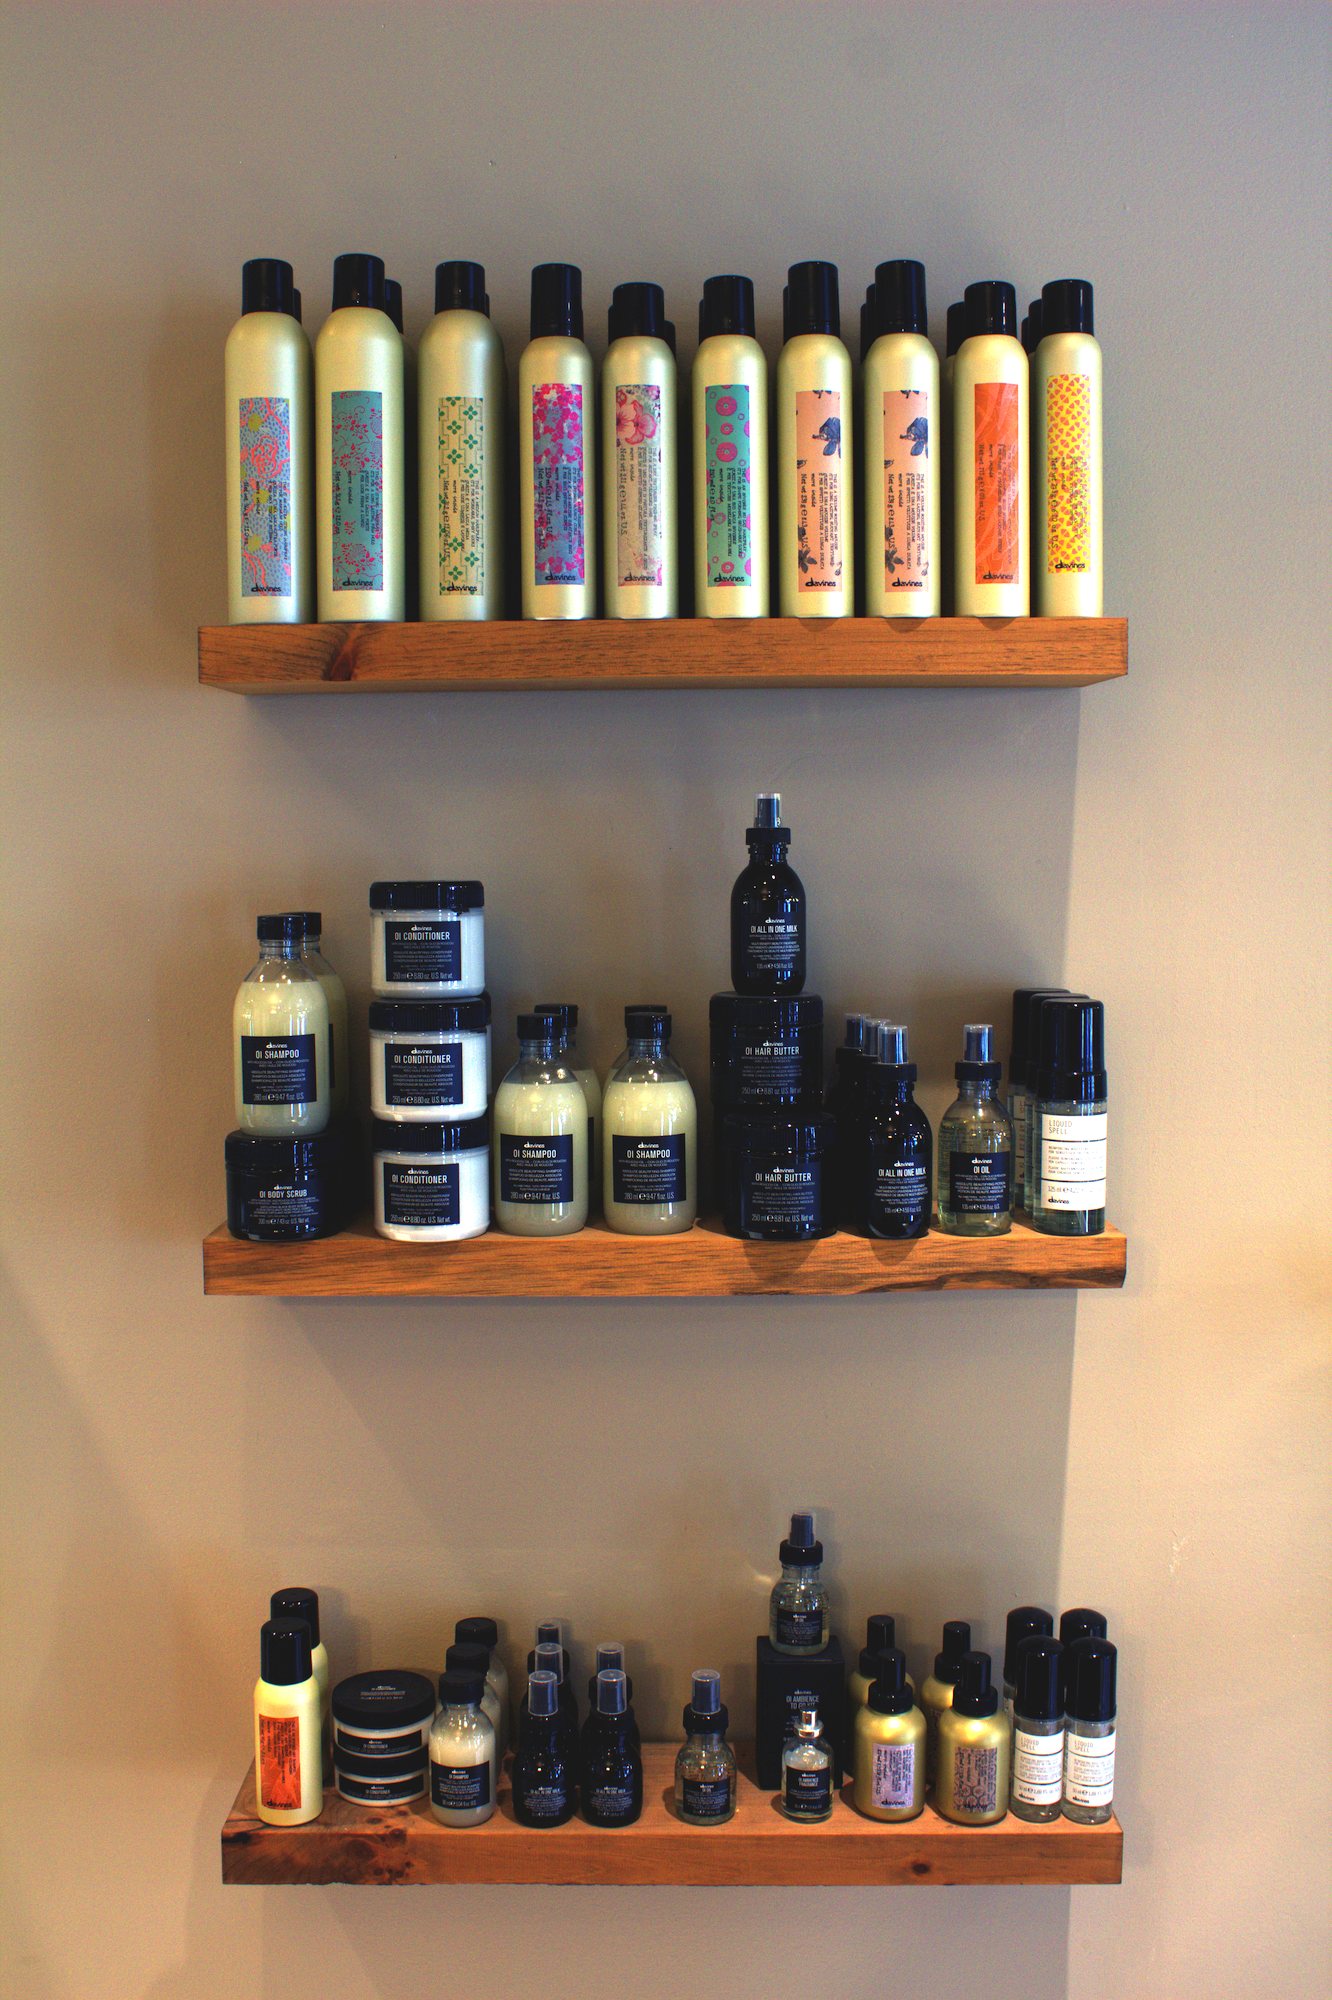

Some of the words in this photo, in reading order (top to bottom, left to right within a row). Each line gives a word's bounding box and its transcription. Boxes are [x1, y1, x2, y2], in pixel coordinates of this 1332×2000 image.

[1055, 560, 1086, 570] davines
[544, 571, 575, 582] davines
[624, 572, 655, 583] davines
[714, 573, 745, 583] davines
[982, 571, 1014, 581] davines
[342, 578, 374, 588] davines
[805, 577, 837, 587] davines
[892, 578, 923, 588] davines
[251, 582, 282, 593] davines
[447, 583, 478, 593] davines
[750, 925, 756, 933] OI
[757, 925, 767, 933] ALL
[768, 925, 774, 933] IN
[774, 925, 785, 933] ONE
[786, 925, 798, 933] MILK
[395, 932, 401, 940] OI
[403, 932, 450, 940] CONDITIONER
[256, 1050, 262, 1059] OI
[265, 1050, 300, 1059] SHAMPOO
[745, 1047, 752, 1055] OI
[755, 1047, 771, 1055] HAIR
[773, 1046, 800, 1055] BUTTER
[394, 1055, 401, 1063] OI
[403, 1055, 451, 1063] CONDITIONER
[522, 1150, 556, 1158] SHAMPOO
[627, 1150, 634, 1158] OI
[636, 1149, 670, 1158] SHAMPOO
[879, 1169, 885, 1177] OI
[885, 1169, 896, 1177] ALL
[897, 1169, 903, 1177] IN
[903, 1168, 914, 1176] ONE
[915, 1167, 927, 1175] MILK
[973, 1165, 980, 1174] OI
[981, 1165, 990, 1174] OIL
[392, 1175, 398, 1183] OI
[400, 1175, 447, 1184] CONDITIONER
[755, 1173, 762, 1181] OI
[765, 1173, 782, 1182] HAIR
[785, 1173, 811, 1182] BUTTER
[259, 1190, 266, 1198] OI
[267, 1190, 285, 1198] BODY
[286, 1189, 308, 1198] SCRUB
[1048, 1196, 1069, 1204] davines
